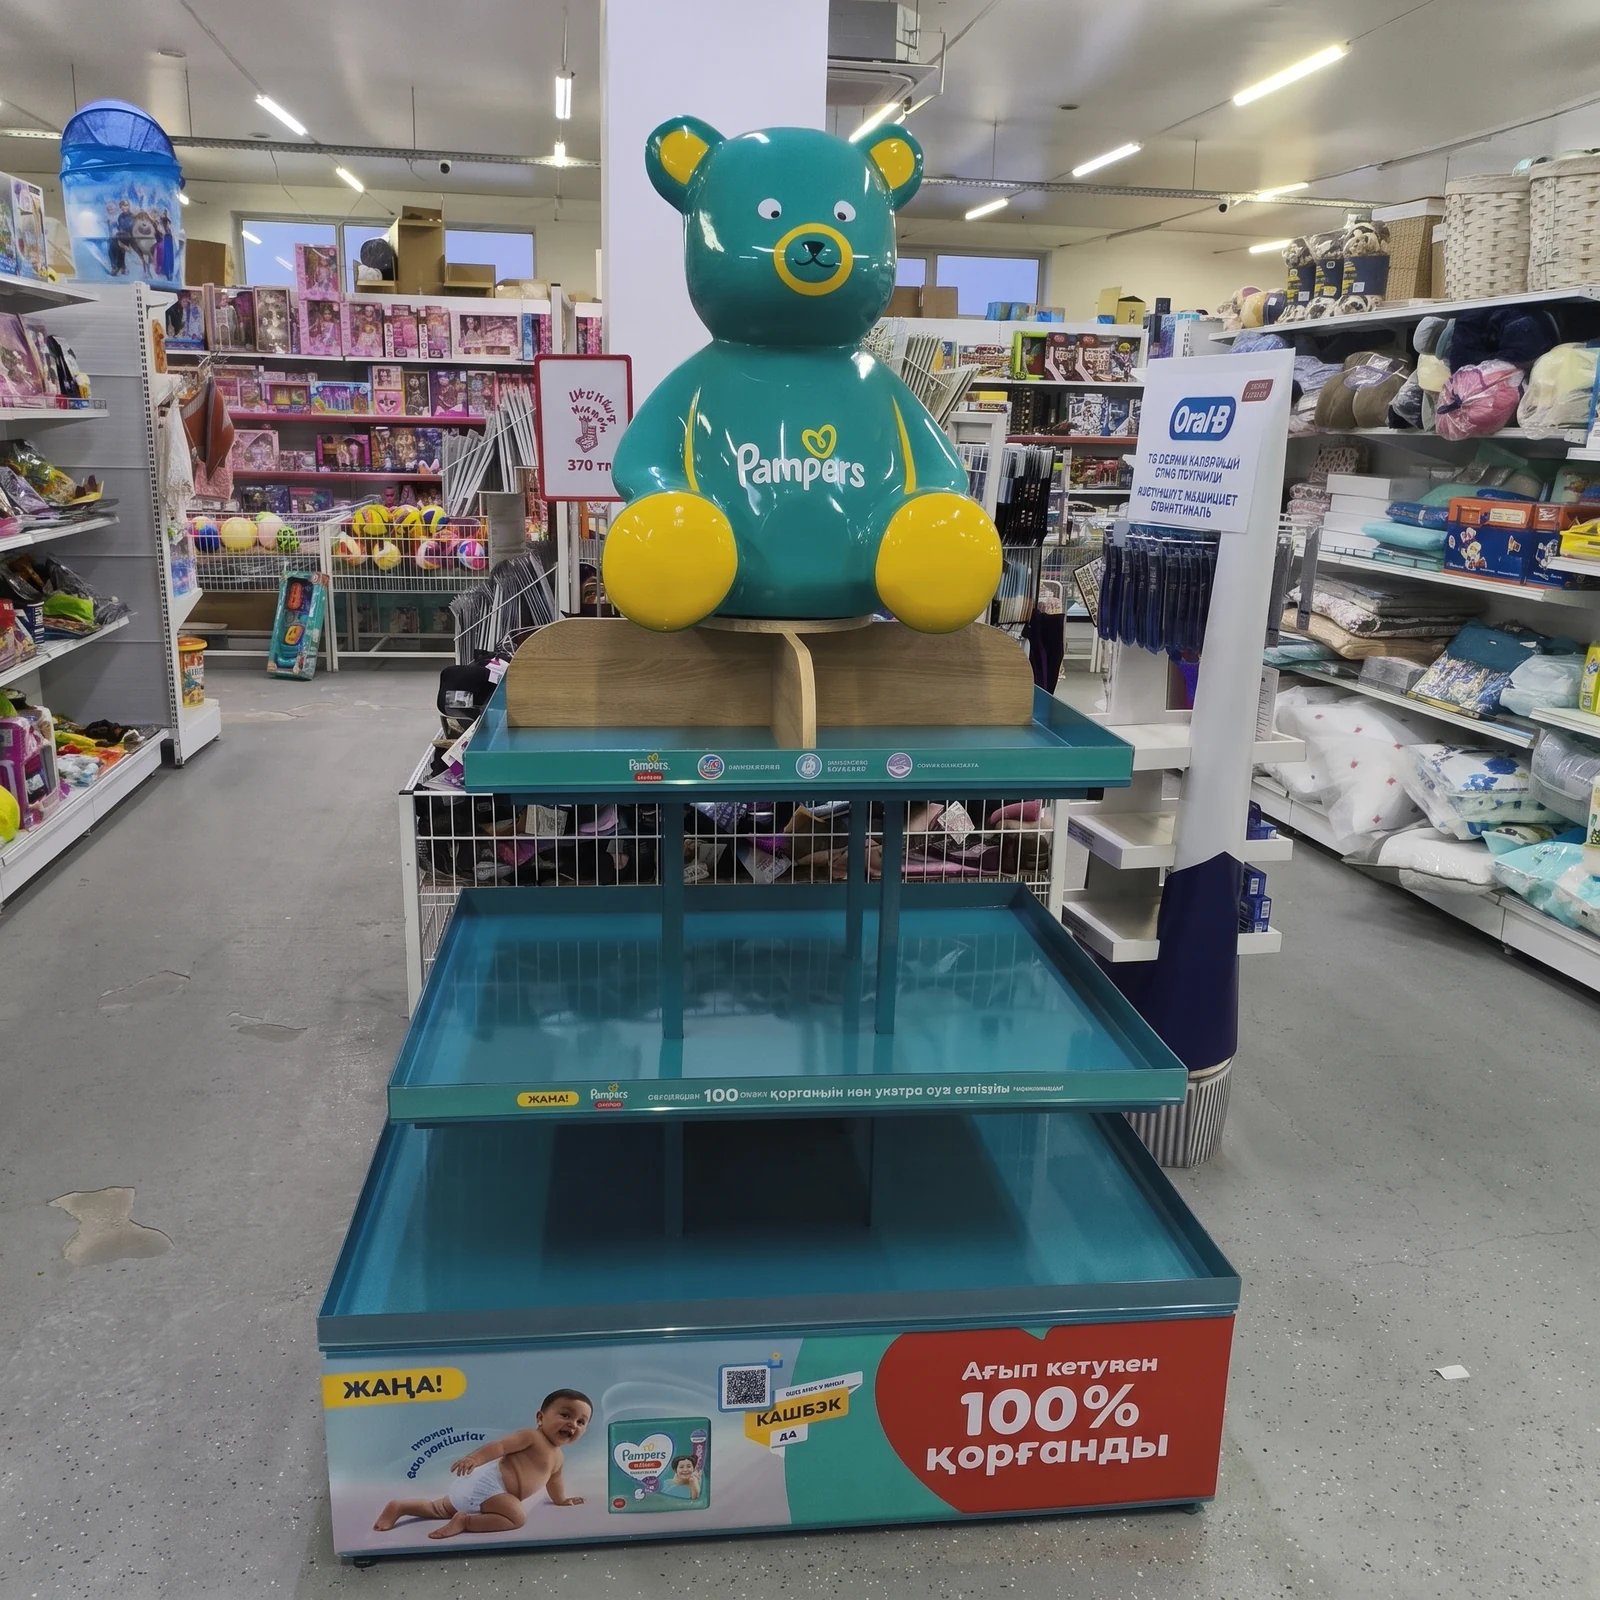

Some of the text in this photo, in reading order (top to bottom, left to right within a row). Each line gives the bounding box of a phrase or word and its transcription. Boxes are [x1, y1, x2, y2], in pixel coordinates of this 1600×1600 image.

[1174, 405, 1231, 434] Oral-B
[567, 459, 594, 471] 370
[737, 443, 866, 491] Pampers
[703, 1088, 739, 1103] 100
[961, 1361, 1038, 1381] Ағып
[343, 1374, 442, 1399] ЖАҢА!
[757, 1397, 841, 1427] КАШБЭК
[960, 1383, 1140, 1436] 100%
[780, 1430, 797, 1441] ДА
[622, 1449, 666, 1462] Pampers
[926, 1434, 1169, 1476] қорғанды
